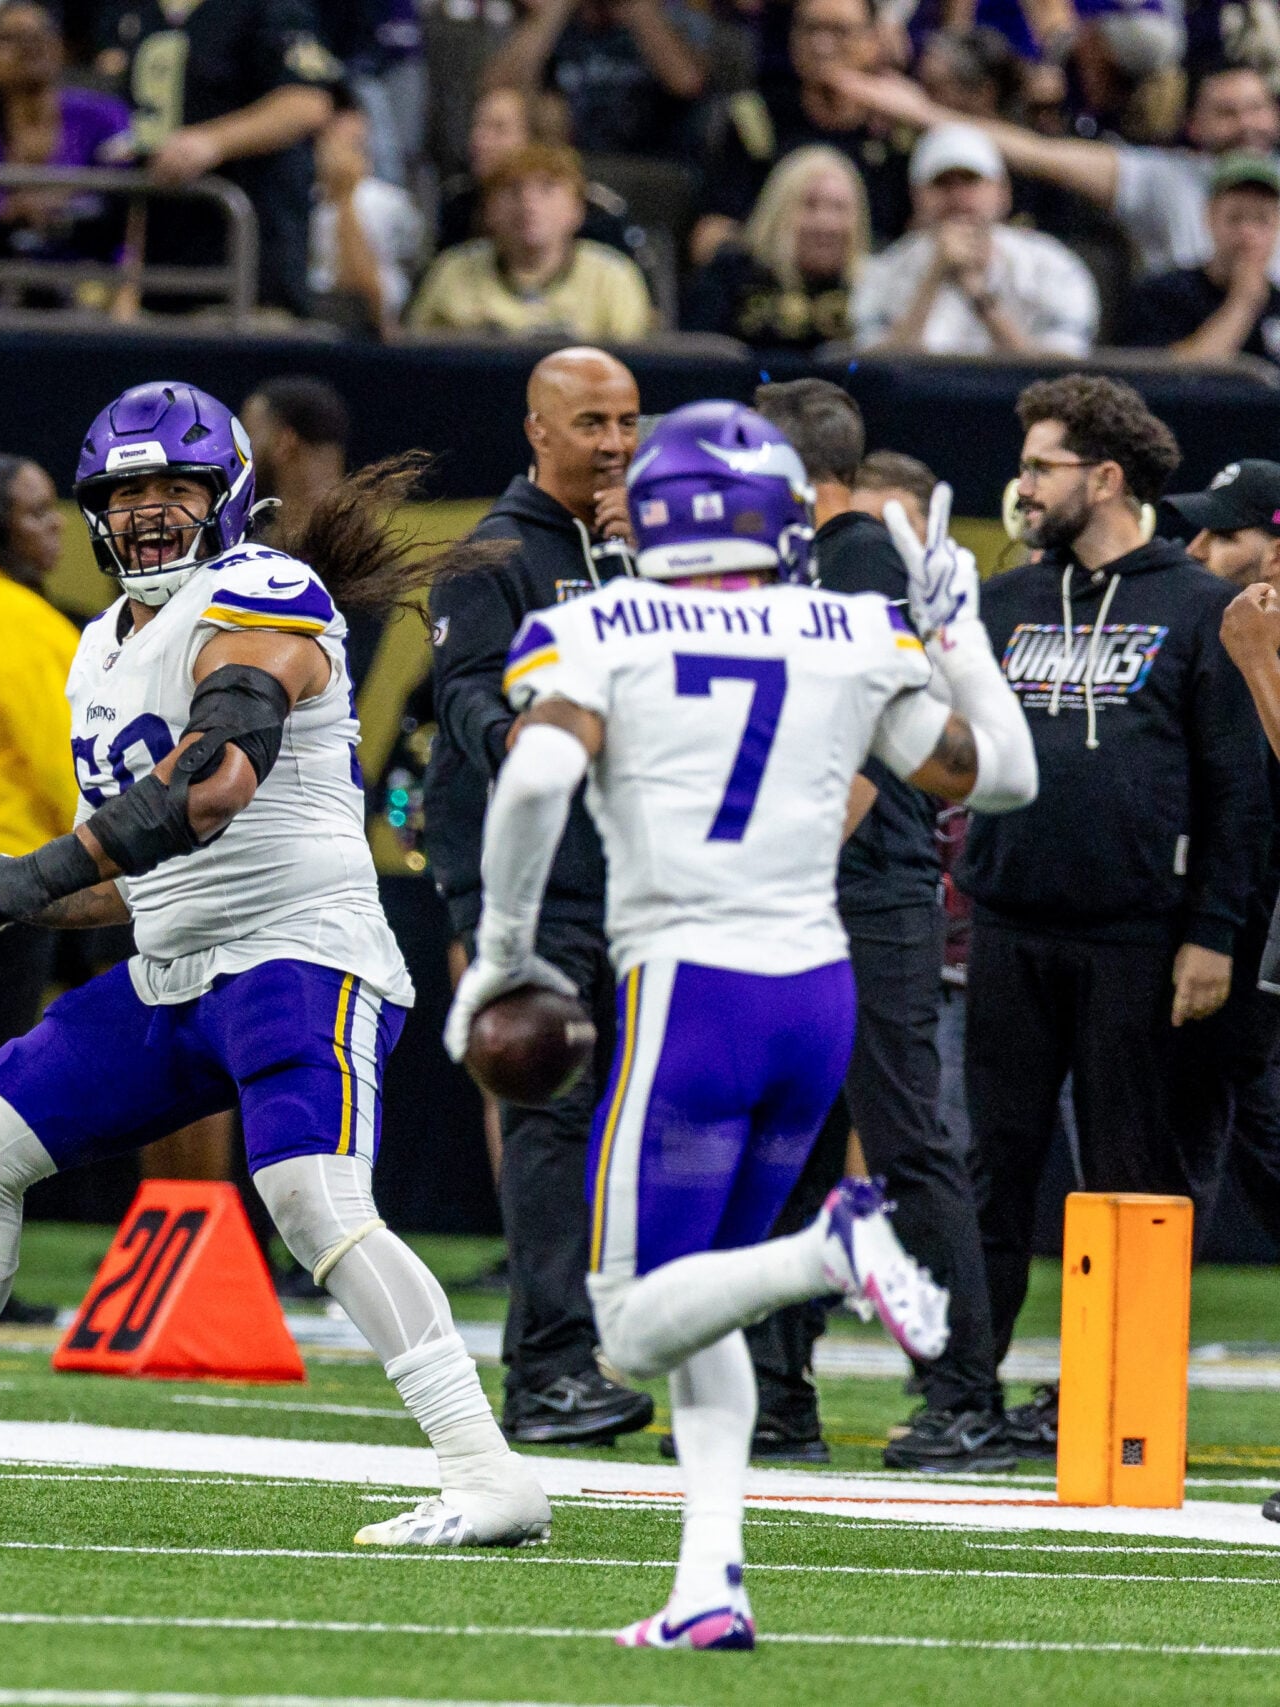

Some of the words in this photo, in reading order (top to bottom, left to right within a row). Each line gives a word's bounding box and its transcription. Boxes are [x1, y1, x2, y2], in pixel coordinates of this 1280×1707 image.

[591, 599, 772, 643] MURPHY
[800, 601, 853, 642] JR
[673, 651, 787, 843] 7
[67, 1209, 209, 1353] 20
